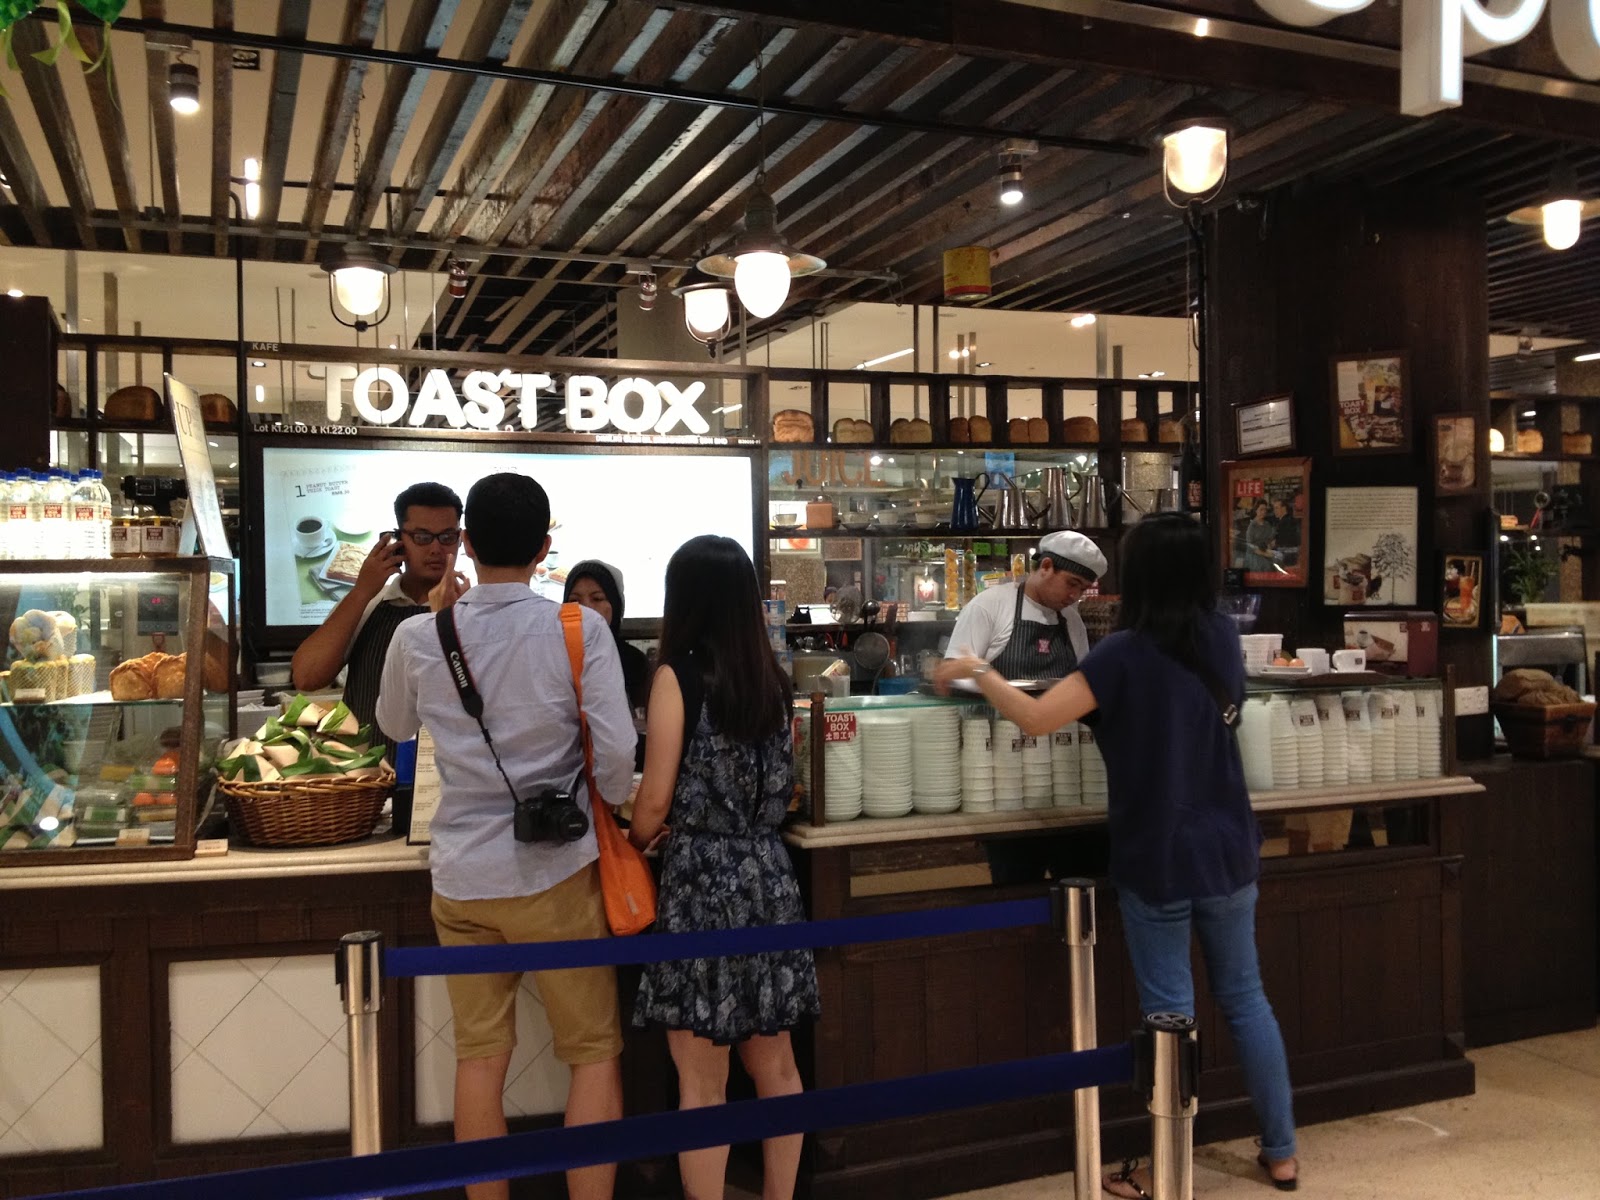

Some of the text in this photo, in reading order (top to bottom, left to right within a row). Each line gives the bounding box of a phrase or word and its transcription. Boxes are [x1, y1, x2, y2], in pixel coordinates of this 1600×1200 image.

[252, 342, 279, 352] KAFE
[308, 365, 710, 434] TOAST BOX
[1340, 400, 1365, 408] TOAST
[253, 424, 269, 433] Lot
[310, 426, 318, 434] &
[1236, 482, 1261, 495] LIFE
[449, 651, 469, 689] Canon
[825, 714, 855, 723] TOAST
[830, 723, 849, 731] BOX
